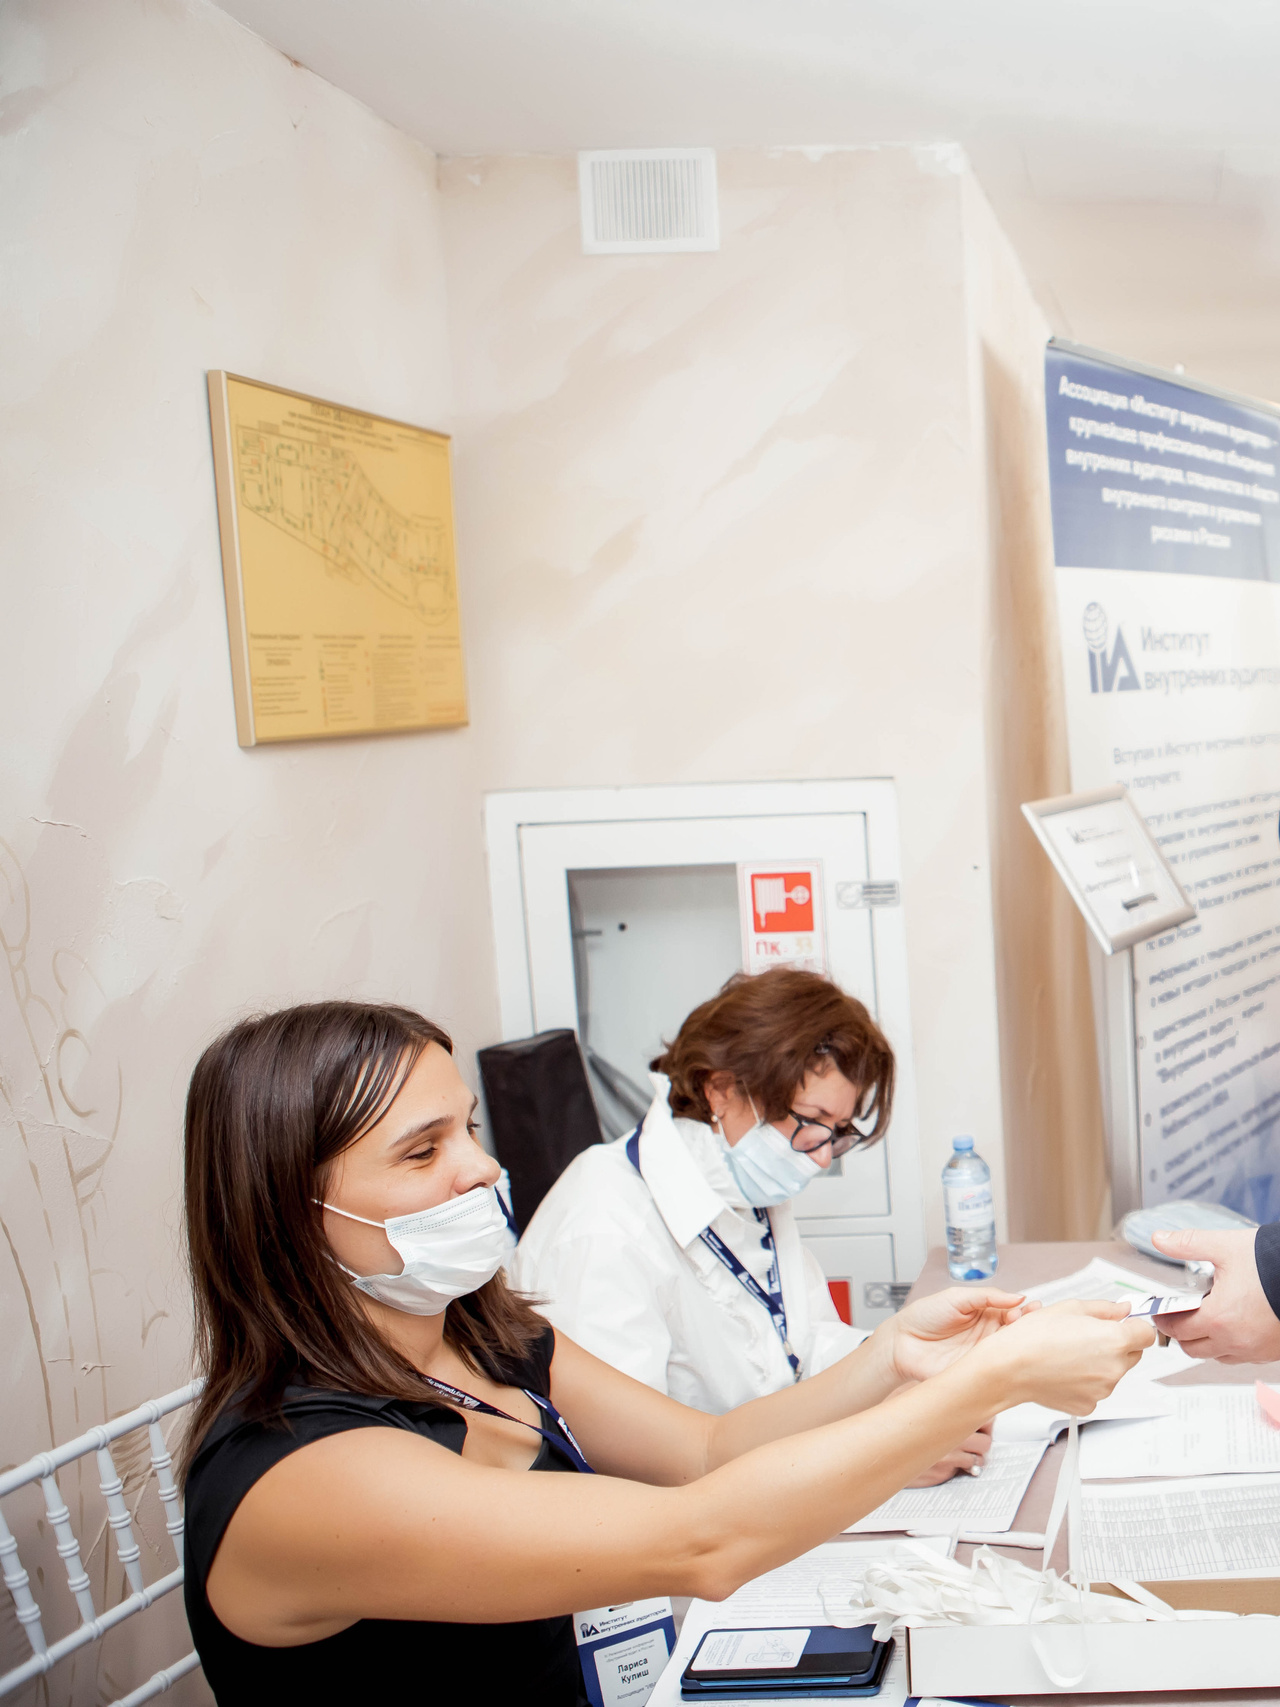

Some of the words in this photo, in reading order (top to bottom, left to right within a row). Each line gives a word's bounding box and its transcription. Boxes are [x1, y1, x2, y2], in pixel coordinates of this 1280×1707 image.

[1140, 626, 1211, 656] Институт
[1144, 667, 1227, 696] внутренних
[600, 1615, 627, 1627] Институт
[600, 1619, 636, 1634] внутренних
[636, 1608, 667, 1623] аудиторов
[617, 1657, 649, 1674] Лариса
[621, 1669, 650, 1685] Кулиш
[616, 1687, 645, 1701] Ассоциация
